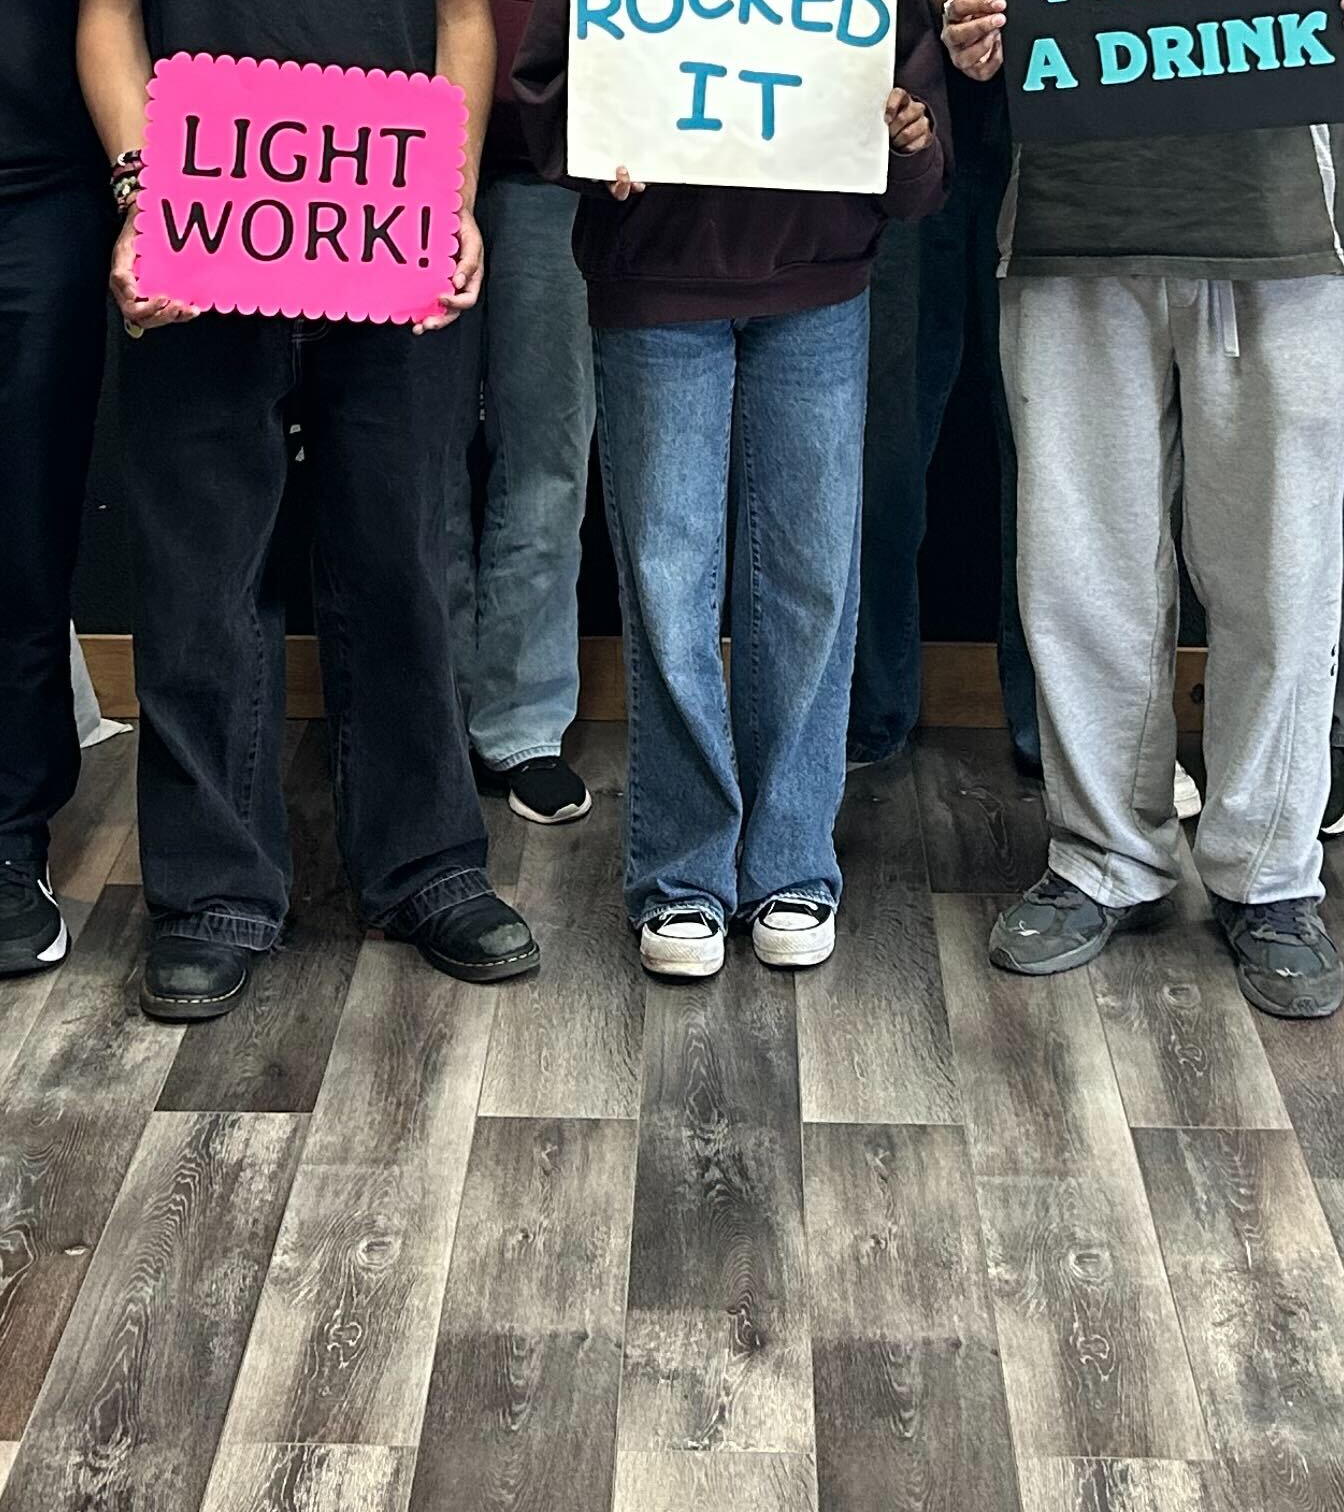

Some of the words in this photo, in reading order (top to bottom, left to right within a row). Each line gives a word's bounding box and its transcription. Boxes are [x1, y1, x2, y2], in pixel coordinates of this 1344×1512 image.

[1023, 38, 1078, 91] A
[1095, 10, 1336, 85] DRINK
[676, 61, 802, 141] IT
[182, 115, 426, 188] LIGHT
[161, 198, 430, 268] WORK!
